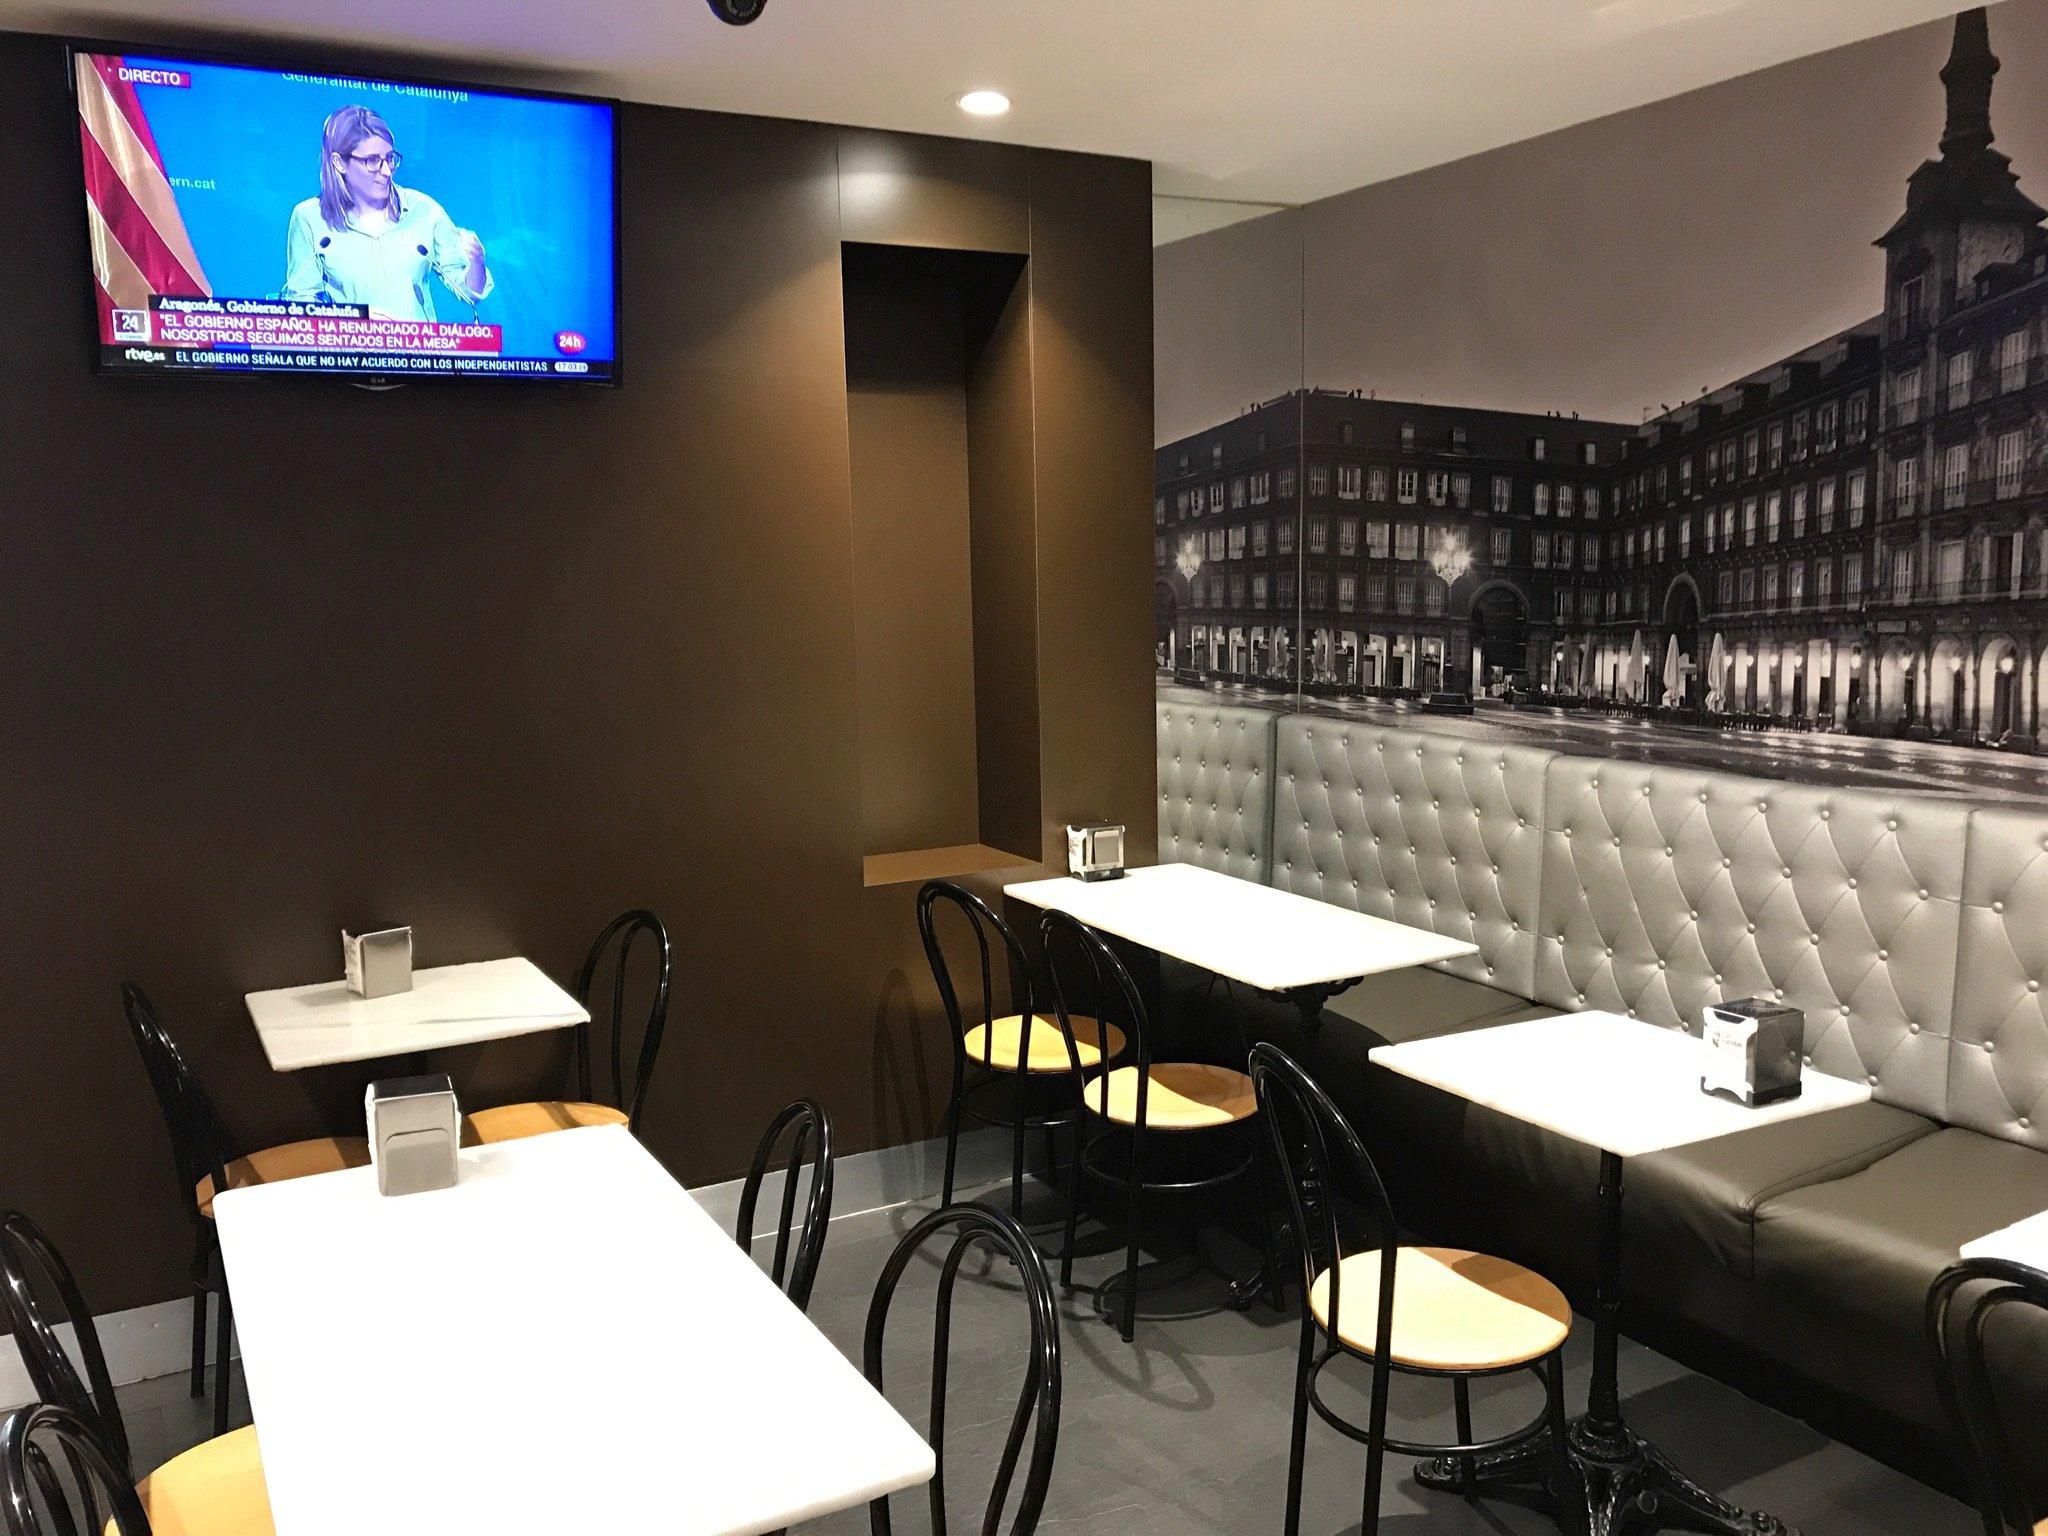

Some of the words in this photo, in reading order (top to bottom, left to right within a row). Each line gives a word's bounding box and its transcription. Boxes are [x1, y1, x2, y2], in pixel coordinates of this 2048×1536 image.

[118, 67, 181, 86] DIRECTO
[159, 298, 225, 313] Aragonés,
[226, 301, 286, 315] Gobierno
[288, 303, 303, 316] de
[306, 304, 360, 318] Cataluña
[121, 315, 139, 330] 24
[184, 315, 253, 331] GOBIERNO
[256, 317, 316, 332] ESPAÑOL
[318, 321, 337, 333] HA
[339, 321, 419, 335] RENUNCIADO
[421, 324, 435, 336] AL
[439, 323, 494, 338] DIÁLOGO.
[160, 328, 243, 343] NOSOSTROS
[247, 332, 314, 345] SEGUIMOS
[317, 334, 384, 347] SENTADOS
[386, 336, 402, 348] EN
[405, 337, 421, 349] LA
[559, 335, 581, 348] 24h
[176, 351, 189, 363] EL
[192, 351, 249, 364] GOBIERNO
[252, 352, 294, 365] SEÑALA
[296, 355, 317, 366] QUE
[320, 356, 335, 366] NO
[338, 356, 359, 368] HAY
[361, 357, 408, 368] ACUERDO
[410, 358, 431, 369] CON
[434, 359, 452, 369] LOS
[454, 359, 548, 372] INDEPENDENTISTAS
